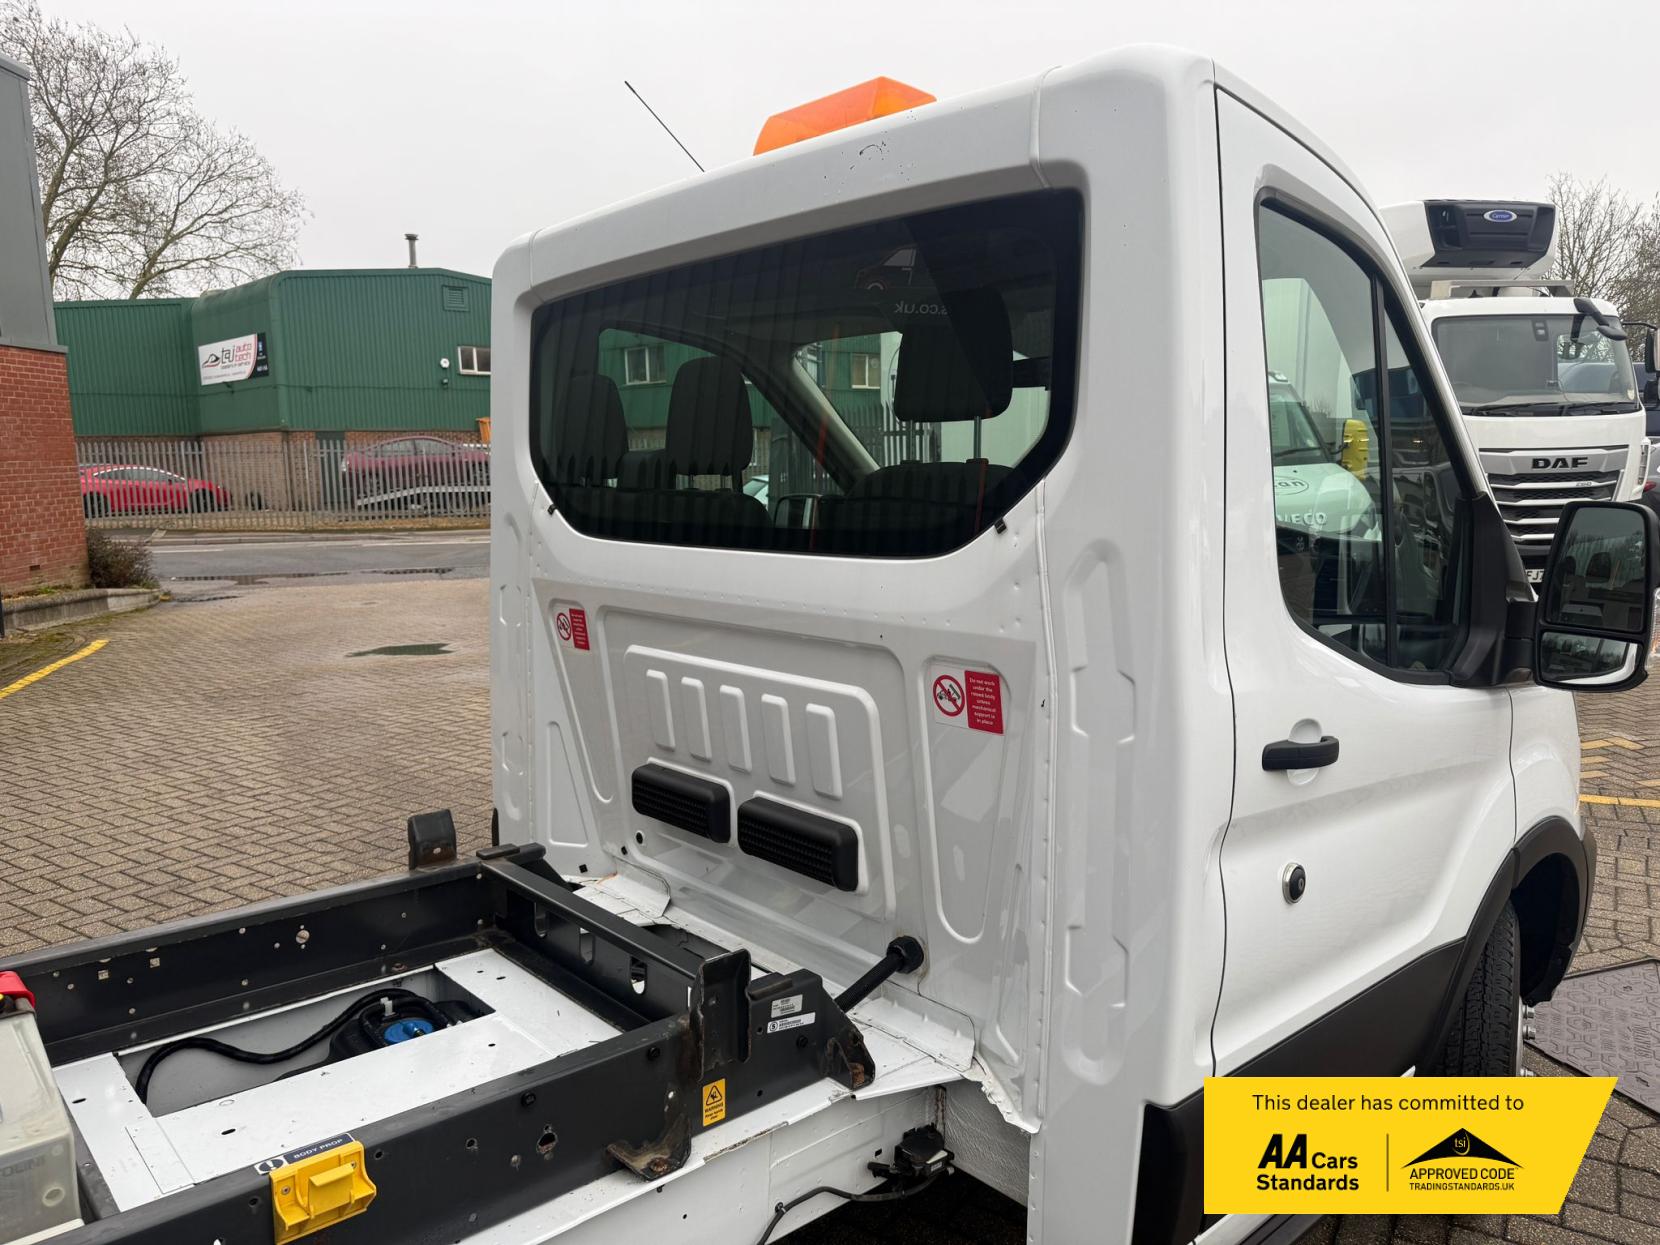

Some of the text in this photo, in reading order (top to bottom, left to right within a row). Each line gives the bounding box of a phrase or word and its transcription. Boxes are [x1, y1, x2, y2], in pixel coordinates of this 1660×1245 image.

[1532, 457, 1588, 469] DAF
[293, 1138, 343, 1159] BODY PROP
